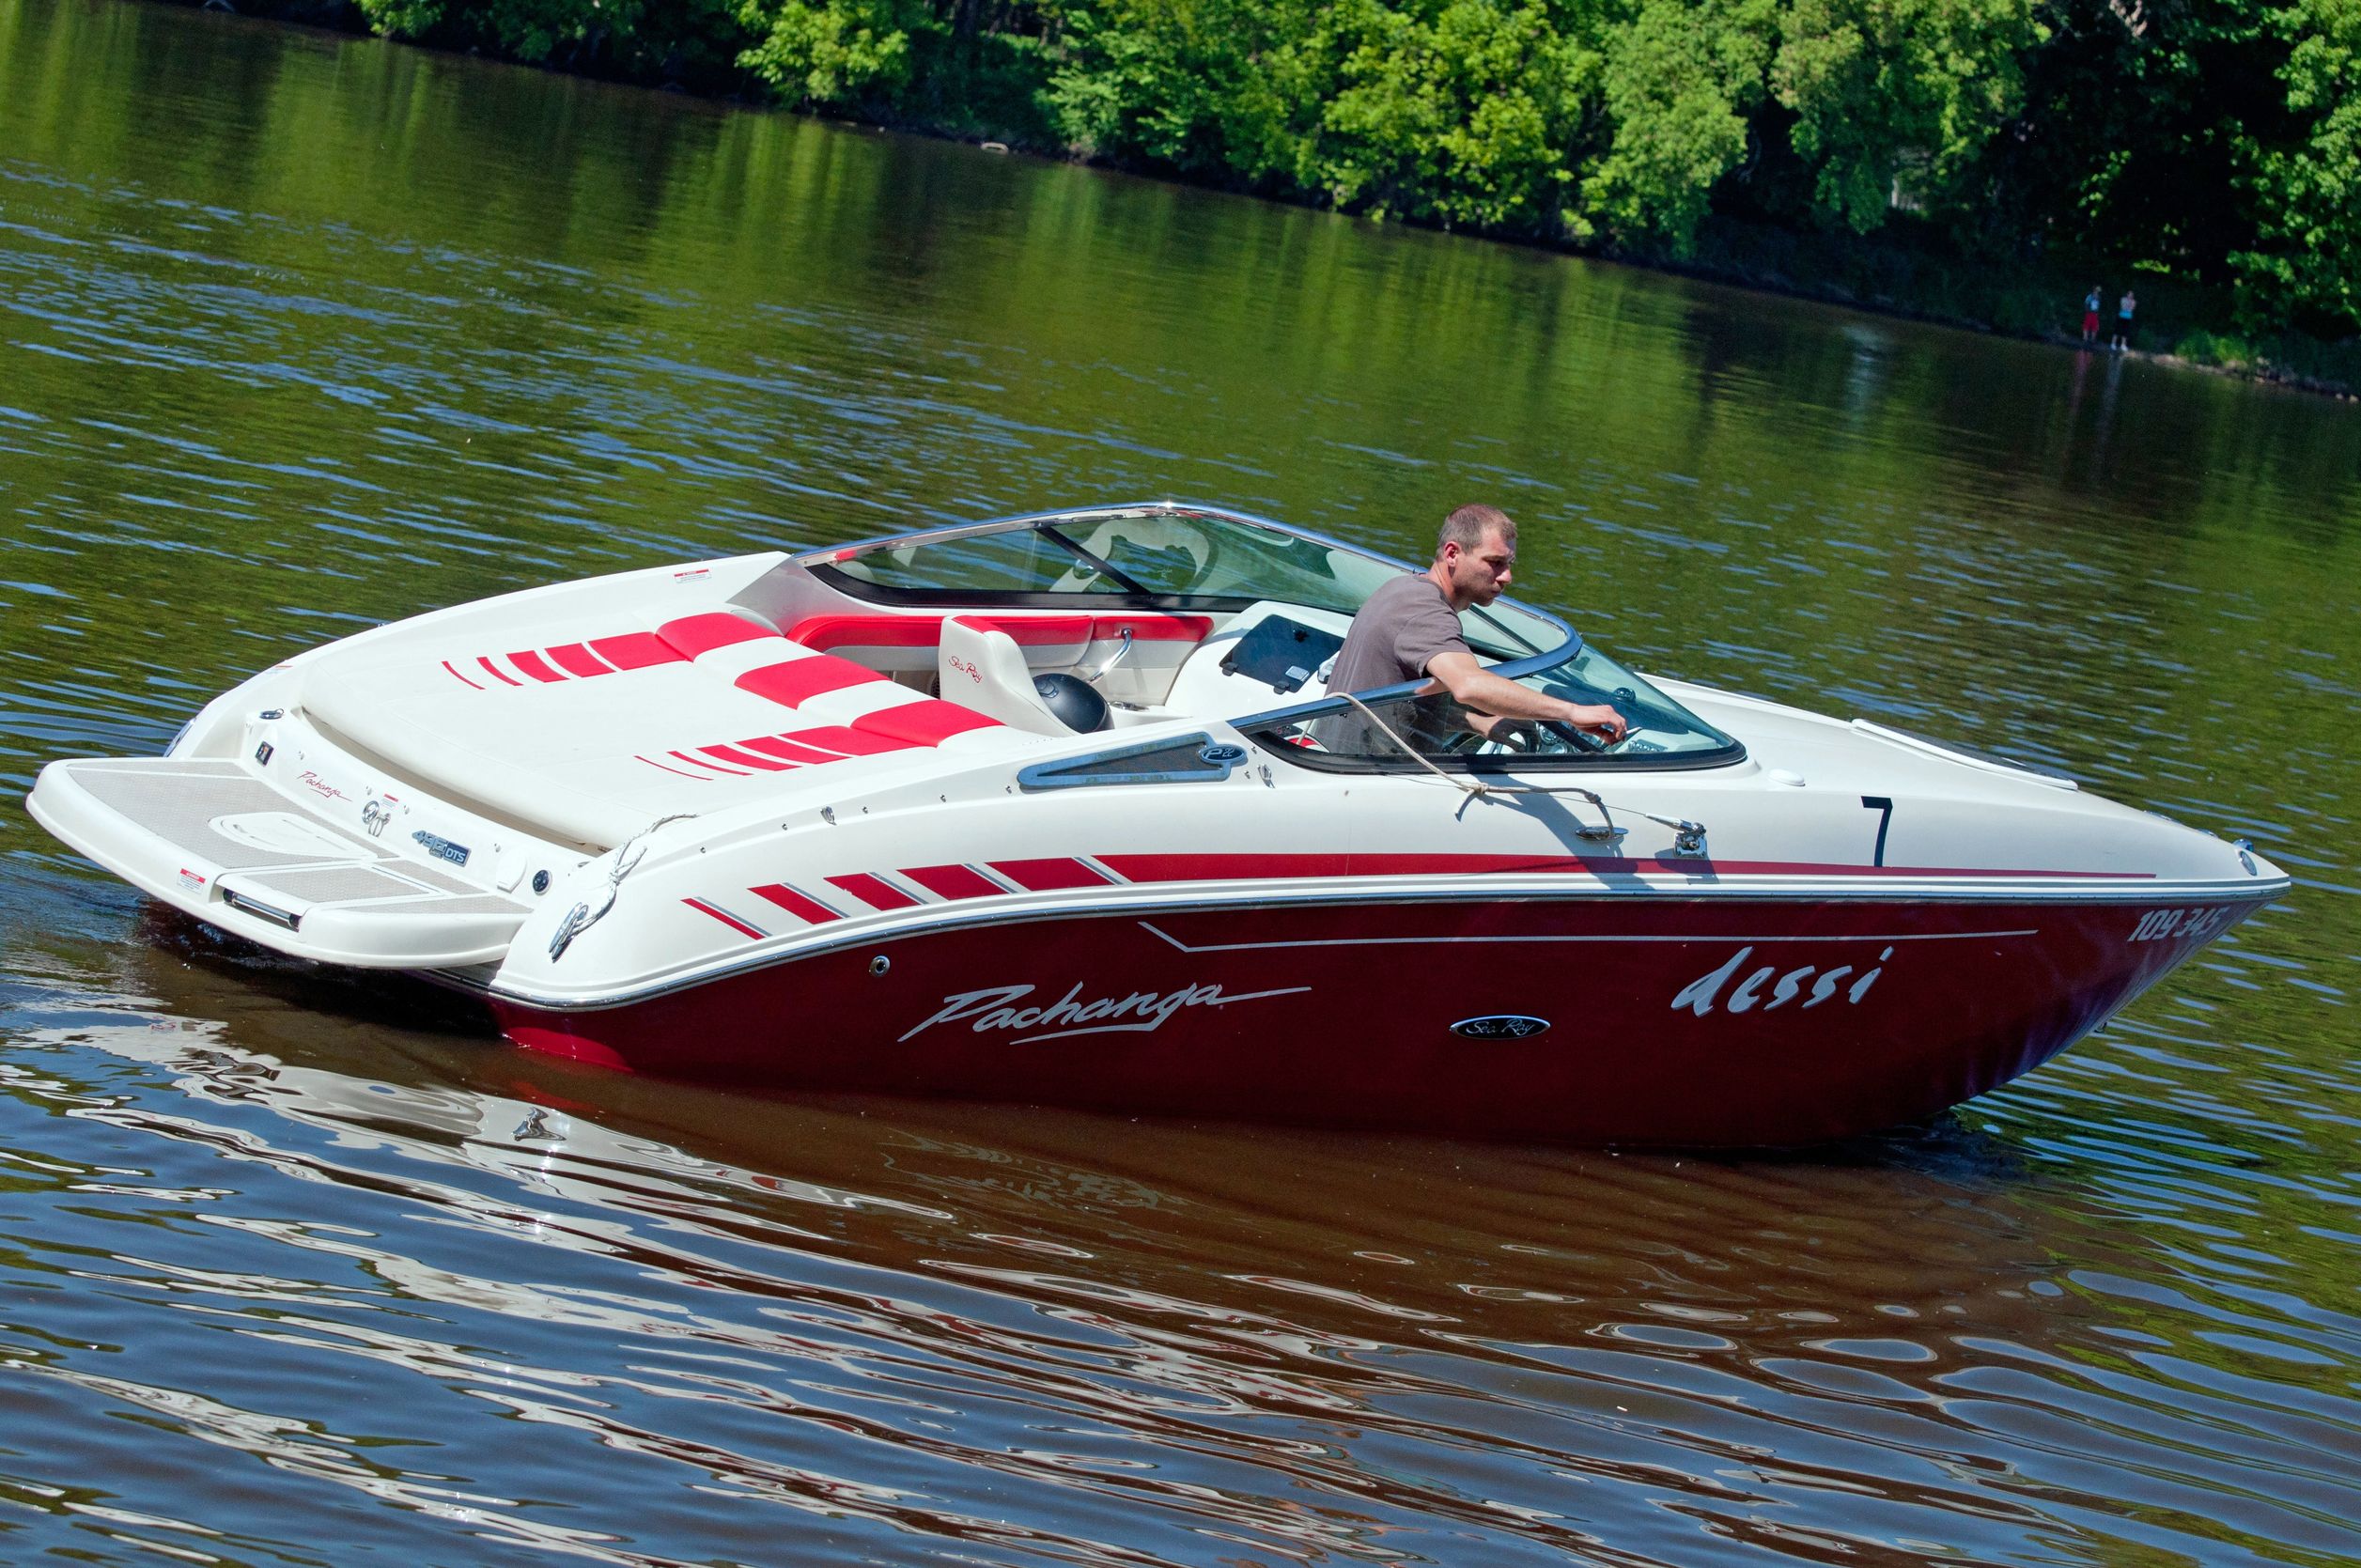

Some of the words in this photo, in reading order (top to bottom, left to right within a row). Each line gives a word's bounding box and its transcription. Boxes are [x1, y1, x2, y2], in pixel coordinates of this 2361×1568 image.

[949, 656, 964, 671] Sea
[966, 662, 983, 683] Ray
[297, 771, 352, 801] Pachanga
[1861, 796, 1893, 867] 7
[445, 847, 466, 862] DTS
[1670, 945, 1894, 1017] dessi
[897, 981, 1312, 1046] Pachanga
[1466, 1021, 1496, 1033] Sea
[1500, 1018, 1535, 1035] Ray
